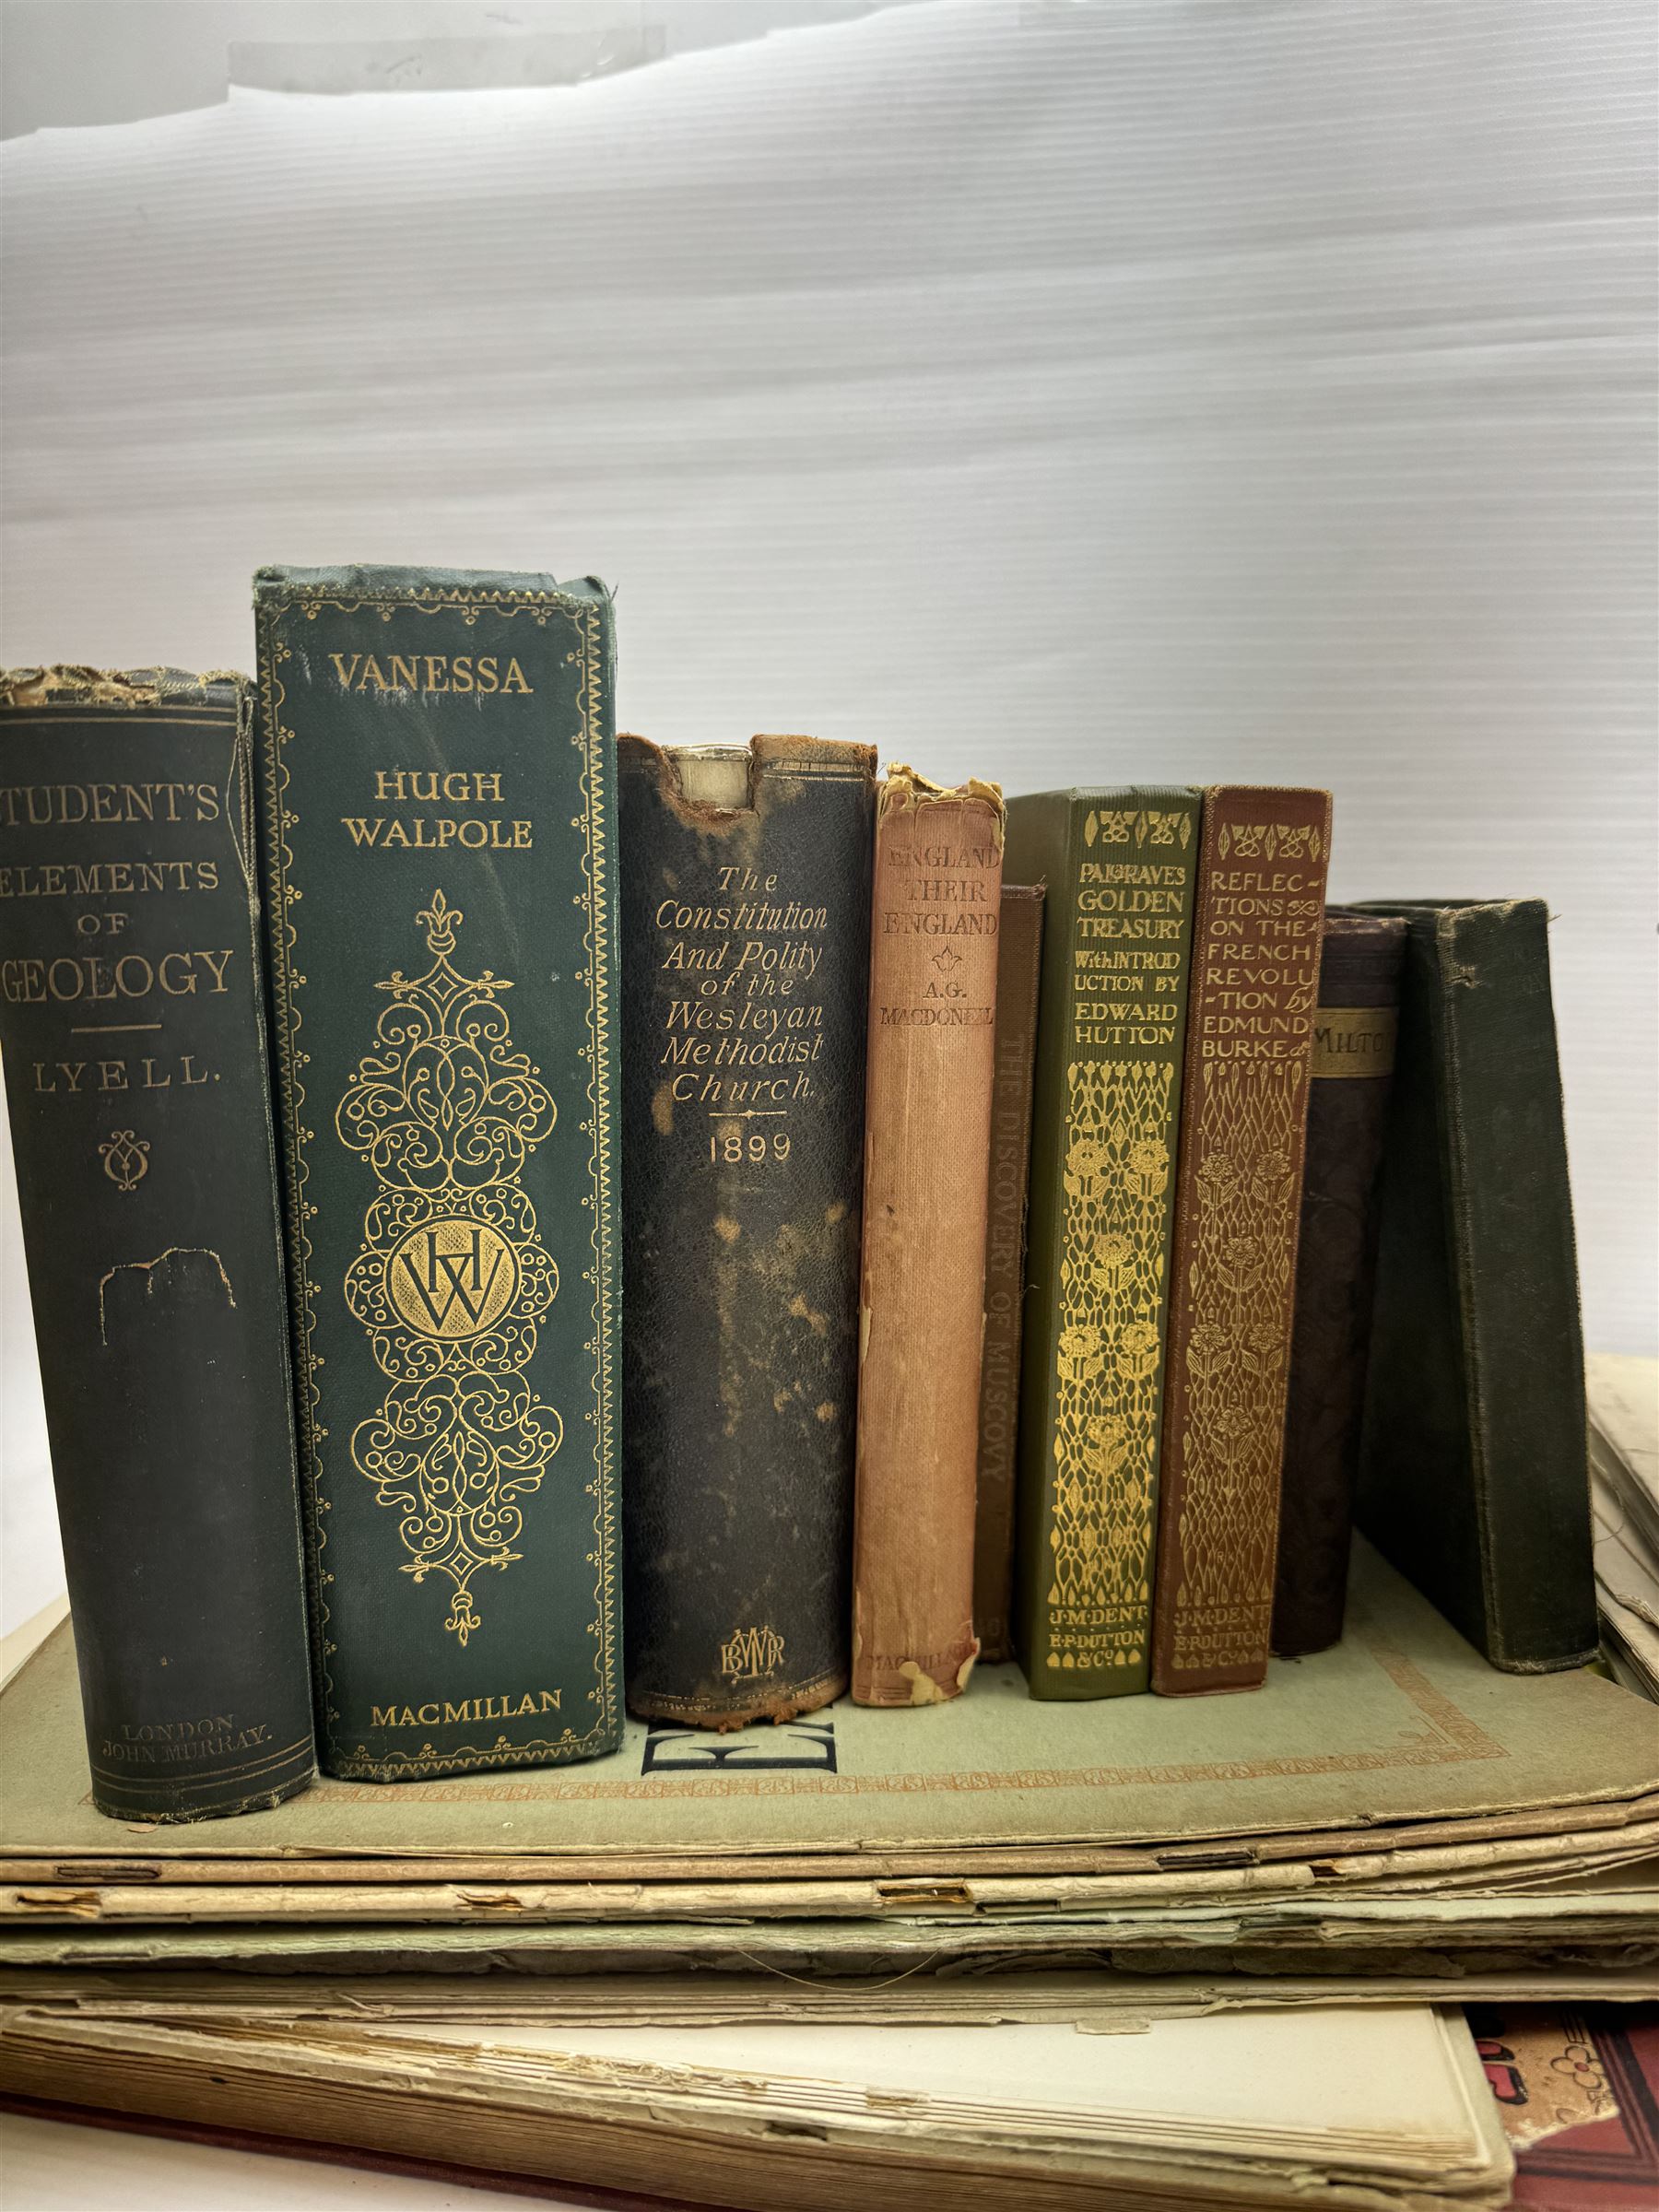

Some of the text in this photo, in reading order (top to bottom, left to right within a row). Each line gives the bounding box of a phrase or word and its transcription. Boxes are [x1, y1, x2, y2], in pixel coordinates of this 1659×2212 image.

[327, 653, 534, 693] VANESSA
[374, 771, 506, 801] HUGH
[340, 818, 533, 848] WALPOLE
[888, 846, 1000, 869] ENGLAND
[0, 862, 219, 898] ELEMENTS
[719, 866, 778, 892] The
[906, 879, 988, 903] THEIR
[1077, 889, 1185, 912] GOLDEN
[76, 912, 127, 935] OF
[655, 900, 829, 931] Constitution
[883, 912, 997, 935] ENGLAND
[1077, 916, 1185, 939] TREASURY
[1210, 920, 1307, 937] ON THE
[662, 941, 823, 981] And Polity
[1207, 943, 1311, 961] FRENCH
[1, 949, 234, 1003] GEOLOGY
[700, 971, 794, 996] of the
[1074, 974, 1180, 992] UCTION BY
[1206, 968, 1313, 986] REVOLU
[1074, 1002, 1179, 1021] EDWARD
[1284, 986, 1313, 1014] by
[665, 1001, 824, 1040] Wesleyan
[1203, 1016, 1309, 1035] EDMUND
[1075, 1025, 1176, 1045] HUTTON
[1313, 1027, 1388, 1053] MILTO
[660, 1033, 824, 1065] Methodist
[1202, 1041, 1290, 1059] BURKE
[710, 1133, 792, 1163] 1899
[981, 1034, 1025, 1483] THE DISCOVERY OF MUSCOVY
[371, 1688, 561, 1726] MACMILLAN
[121, 1713, 234, 1740] LONDON
[102, 1739, 156, 1763] JOHN
